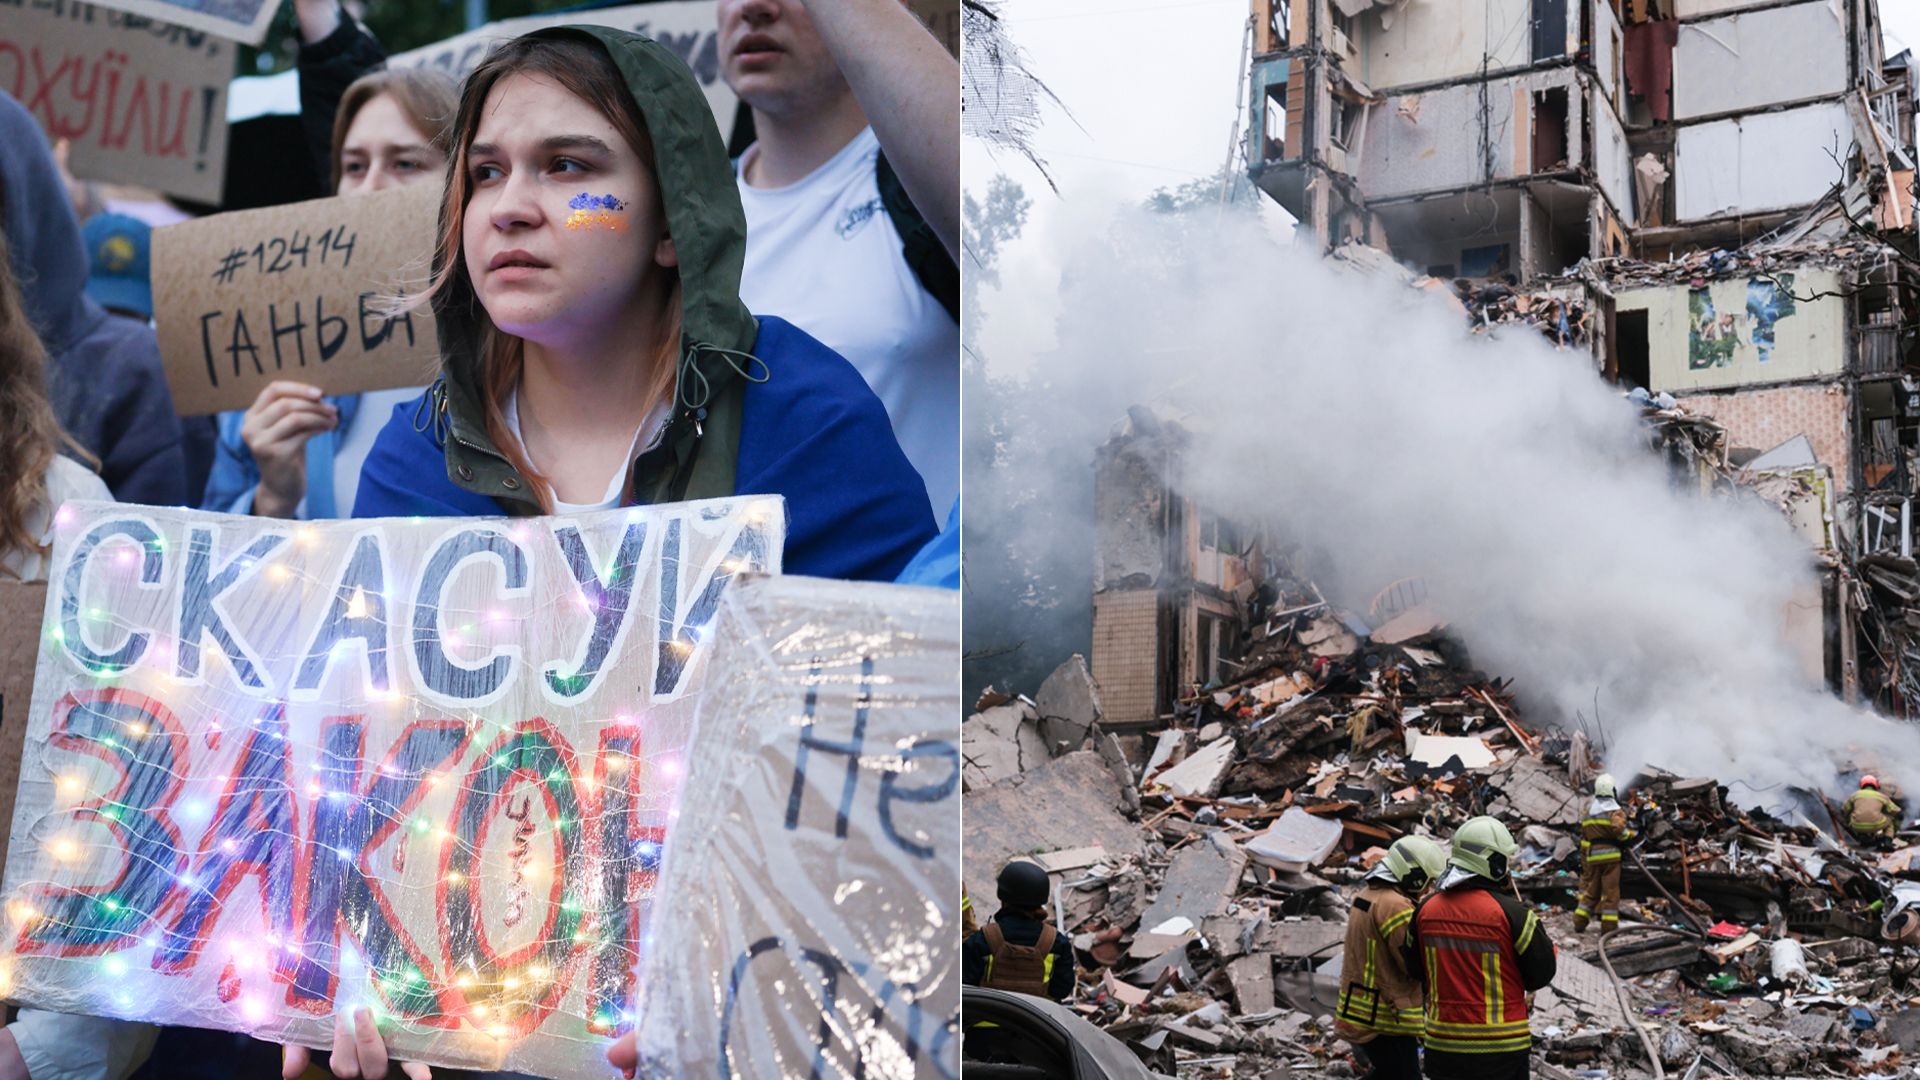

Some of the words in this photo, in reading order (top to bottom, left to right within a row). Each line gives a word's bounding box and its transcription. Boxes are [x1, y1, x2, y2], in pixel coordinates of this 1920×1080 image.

[212, 224, 358, 285] #12414
[200, 287, 415, 388] ГАНЬБА
[60, 503, 783, 708] СКАСУЙ
